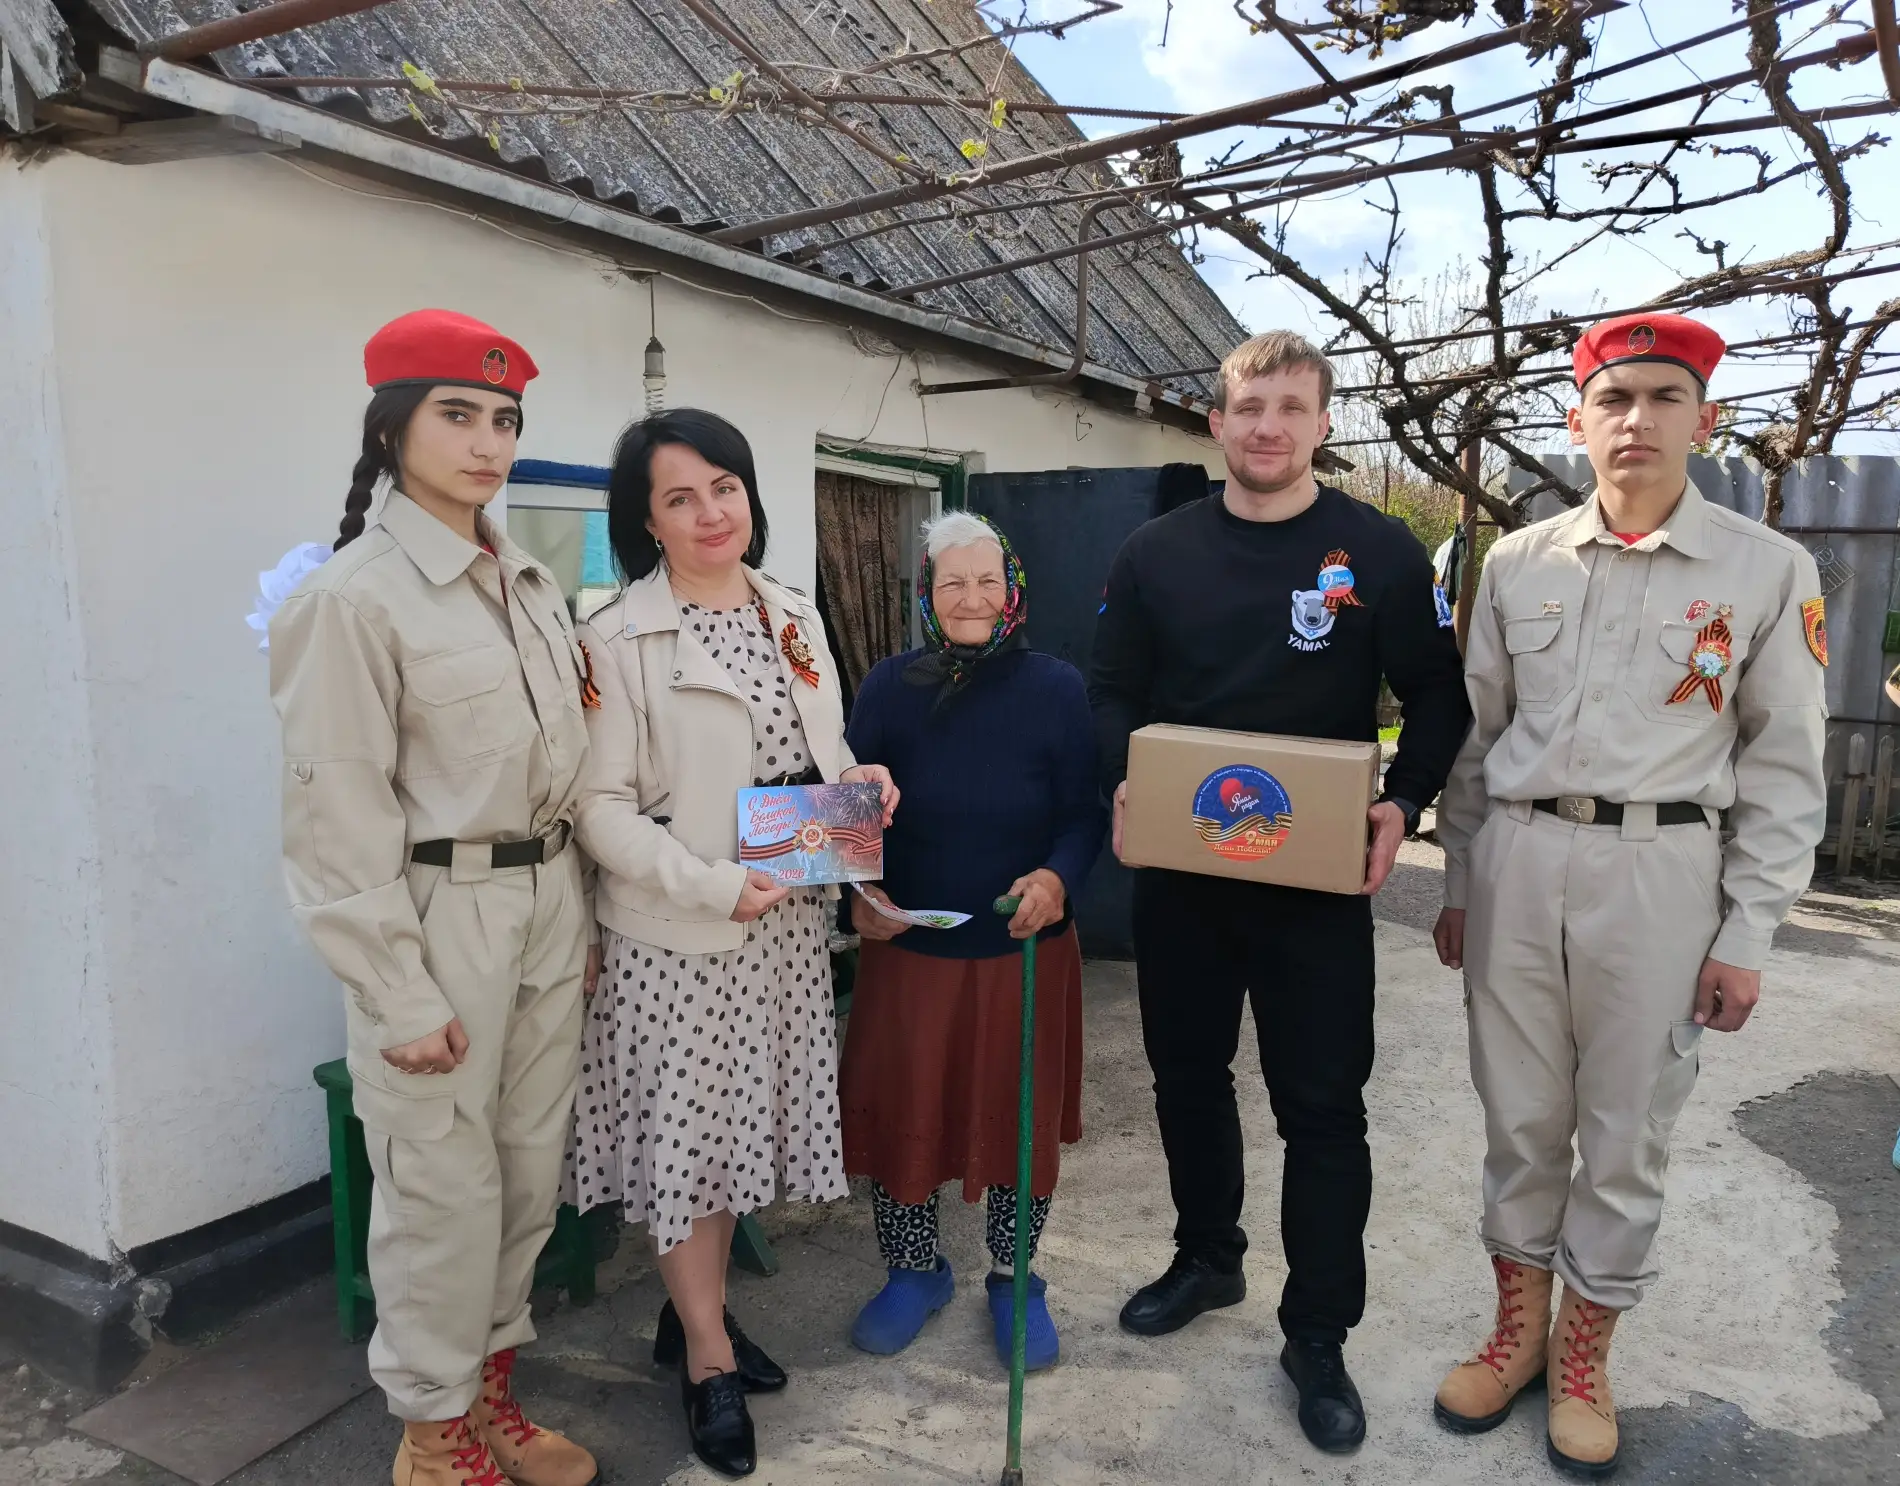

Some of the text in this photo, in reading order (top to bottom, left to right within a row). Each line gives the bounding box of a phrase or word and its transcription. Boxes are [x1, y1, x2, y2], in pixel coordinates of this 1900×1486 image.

[1323, 573, 1333, 590] 9
[1288, 634, 1330, 651] YAMAL
[748, 795, 757, 810] С
[1229, 792, 1252, 813] Ямал
[750, 800, 797, 823] Великой
[748, 812, 801, 838] Победы!
[1245, 830, 1257, 845] 9
